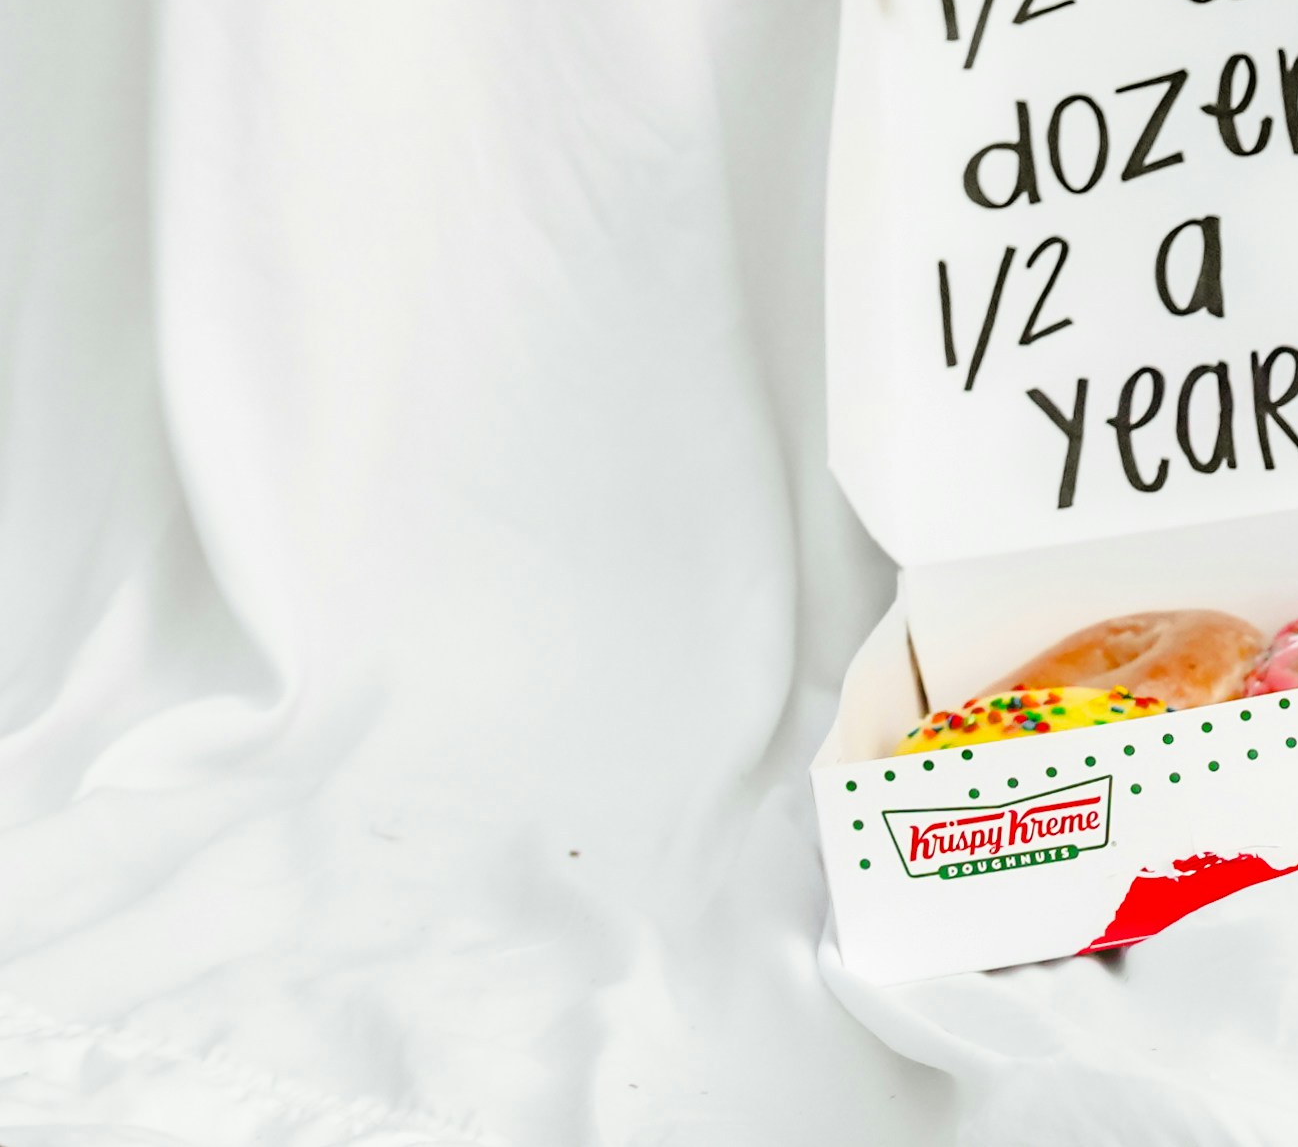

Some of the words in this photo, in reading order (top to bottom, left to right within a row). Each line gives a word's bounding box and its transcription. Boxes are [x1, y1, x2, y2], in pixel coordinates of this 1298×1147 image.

[937, 236, 1073, 391] 1/2
[1154, 214, 1226, 319] a
[910, 812, 1005, 861] Krispy
[1008, 796, 1101, 845] Kreme
[946, 848, 1072, 878] DOUGHNUTS
